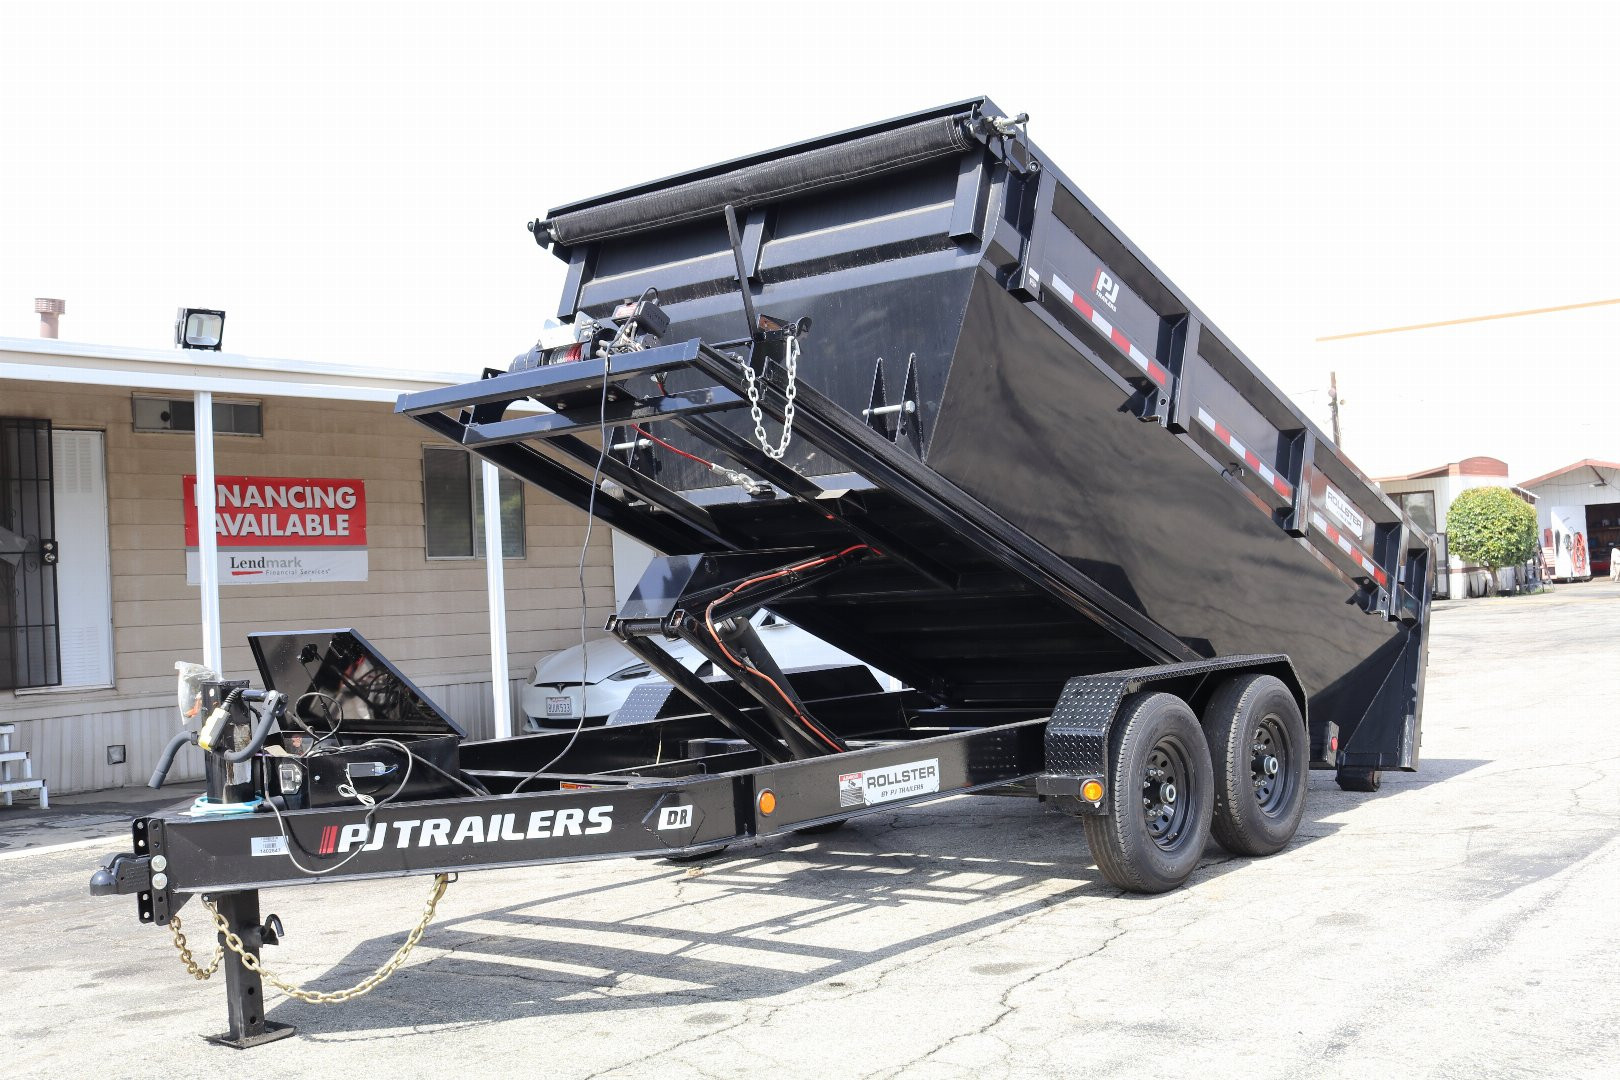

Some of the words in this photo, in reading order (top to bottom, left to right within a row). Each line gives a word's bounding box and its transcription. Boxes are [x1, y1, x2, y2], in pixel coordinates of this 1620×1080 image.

[1097, 272, 1119, 303] PJ
[194, 484, 357, 509] NANCING
[230, 556, 302, 569] Lendmark
[866, 765, 936, 789] ROLLSTER
[899, 783, 924, 794] TRAILERS
[337, 823, 387, 853] PJ
[392, 805, 614, 849] TRAILERS
[667, 809, 688, 826] DR
